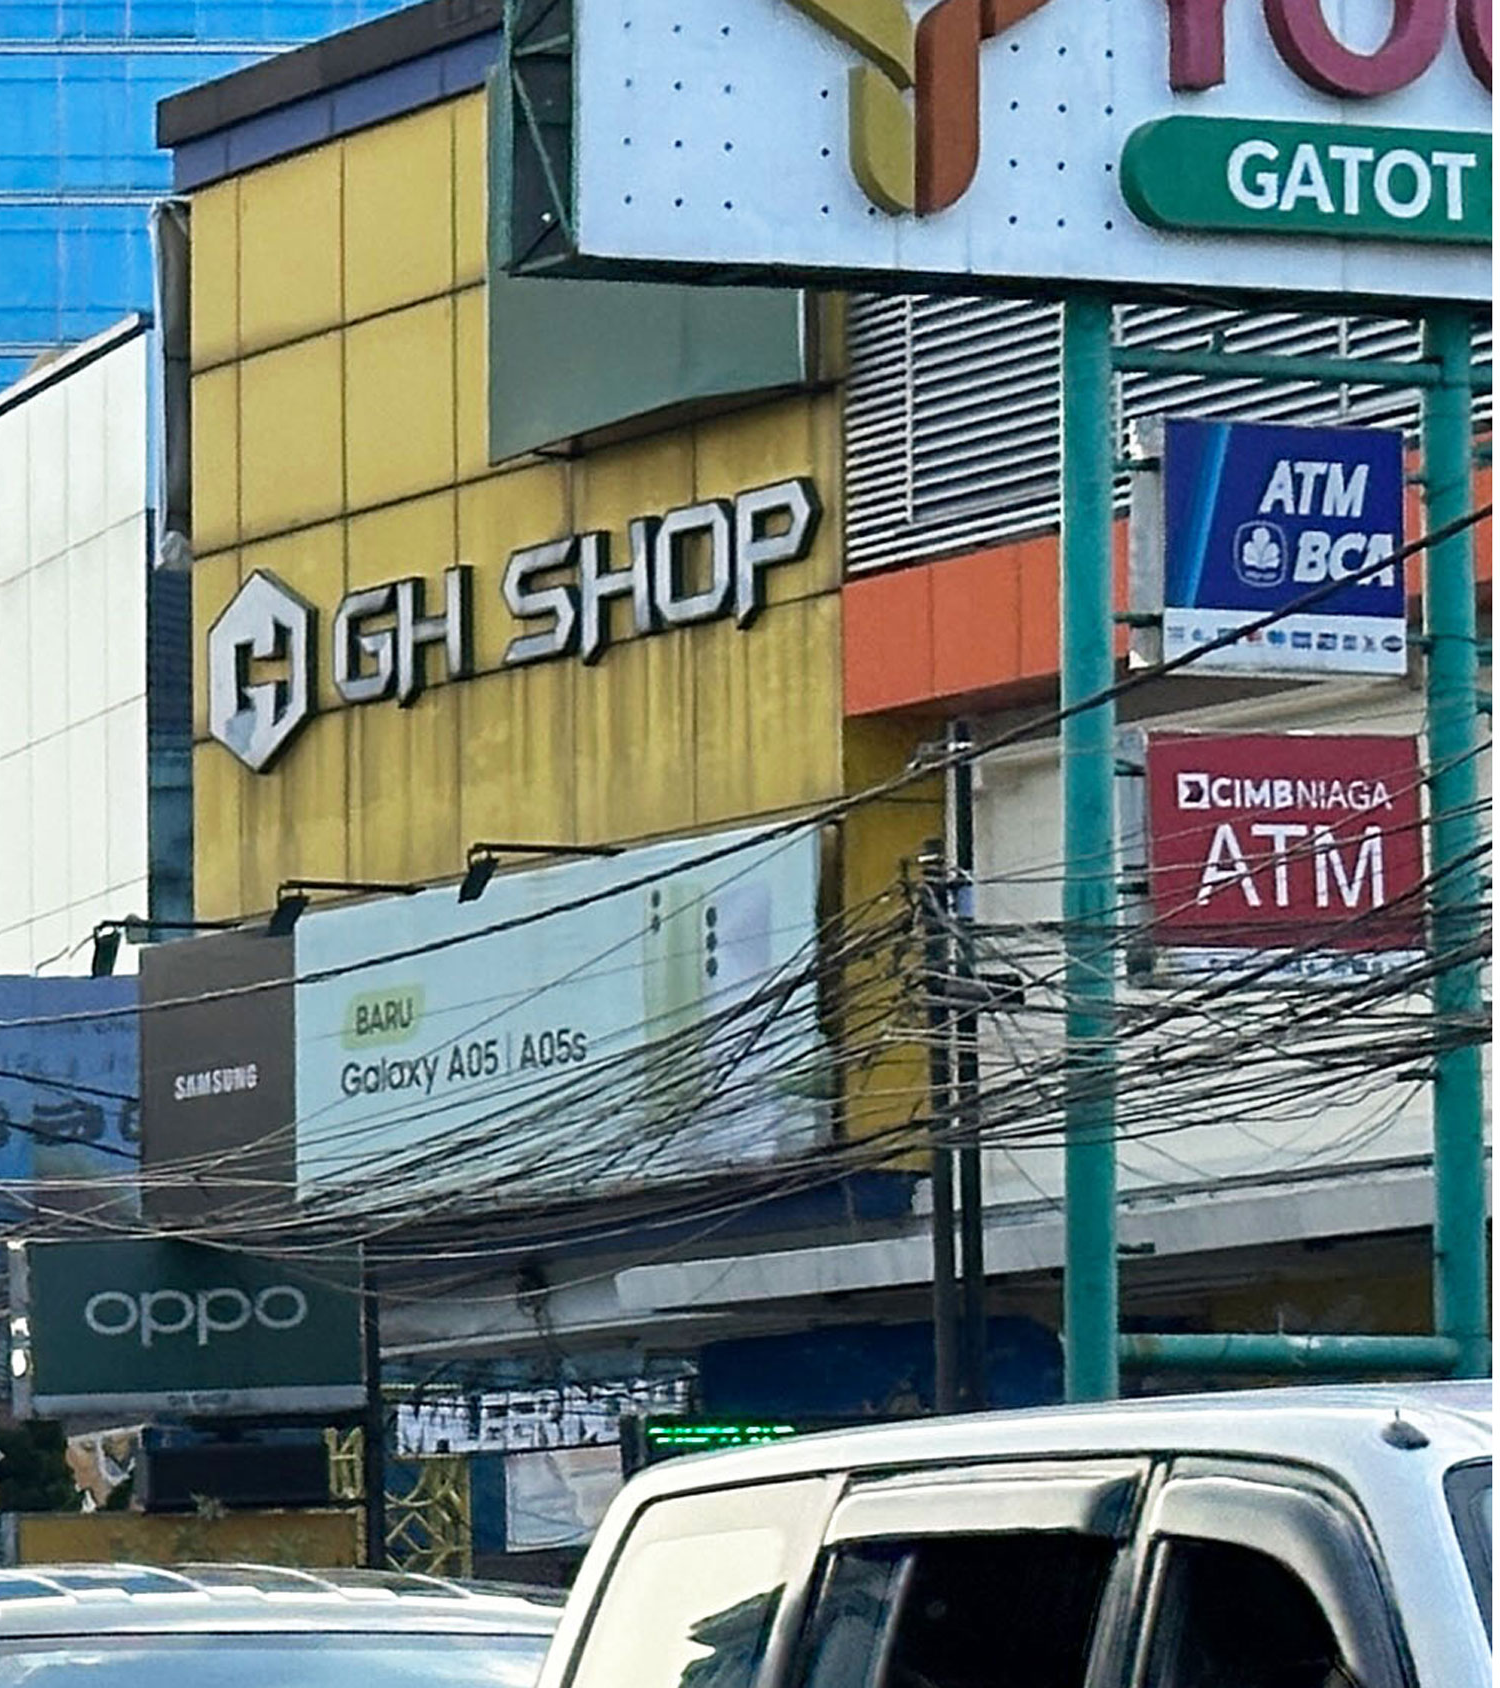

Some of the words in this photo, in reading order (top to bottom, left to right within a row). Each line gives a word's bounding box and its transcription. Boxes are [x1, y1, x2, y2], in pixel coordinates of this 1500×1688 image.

[1227, 139, 1477, 221] GATOT
[1257, 459, 1369, 517] ATM
[1293, 531, 1395, 587] BCA
[332, 566, 473, 708] GH
[502, 477, 822, 666] SHOP
[1197, 824, 1384, 907] ATM
[356, 999, 414, 1036] BARU
[174, 1063, 258, 1101] SAMSUNG
[341, 1052, 440, 1096] Galaxy
[447, 1040, 499, 1081] A05
[520, 1029, 588, 1070] A05s
[85, 1285, 307, 1347] oppo
